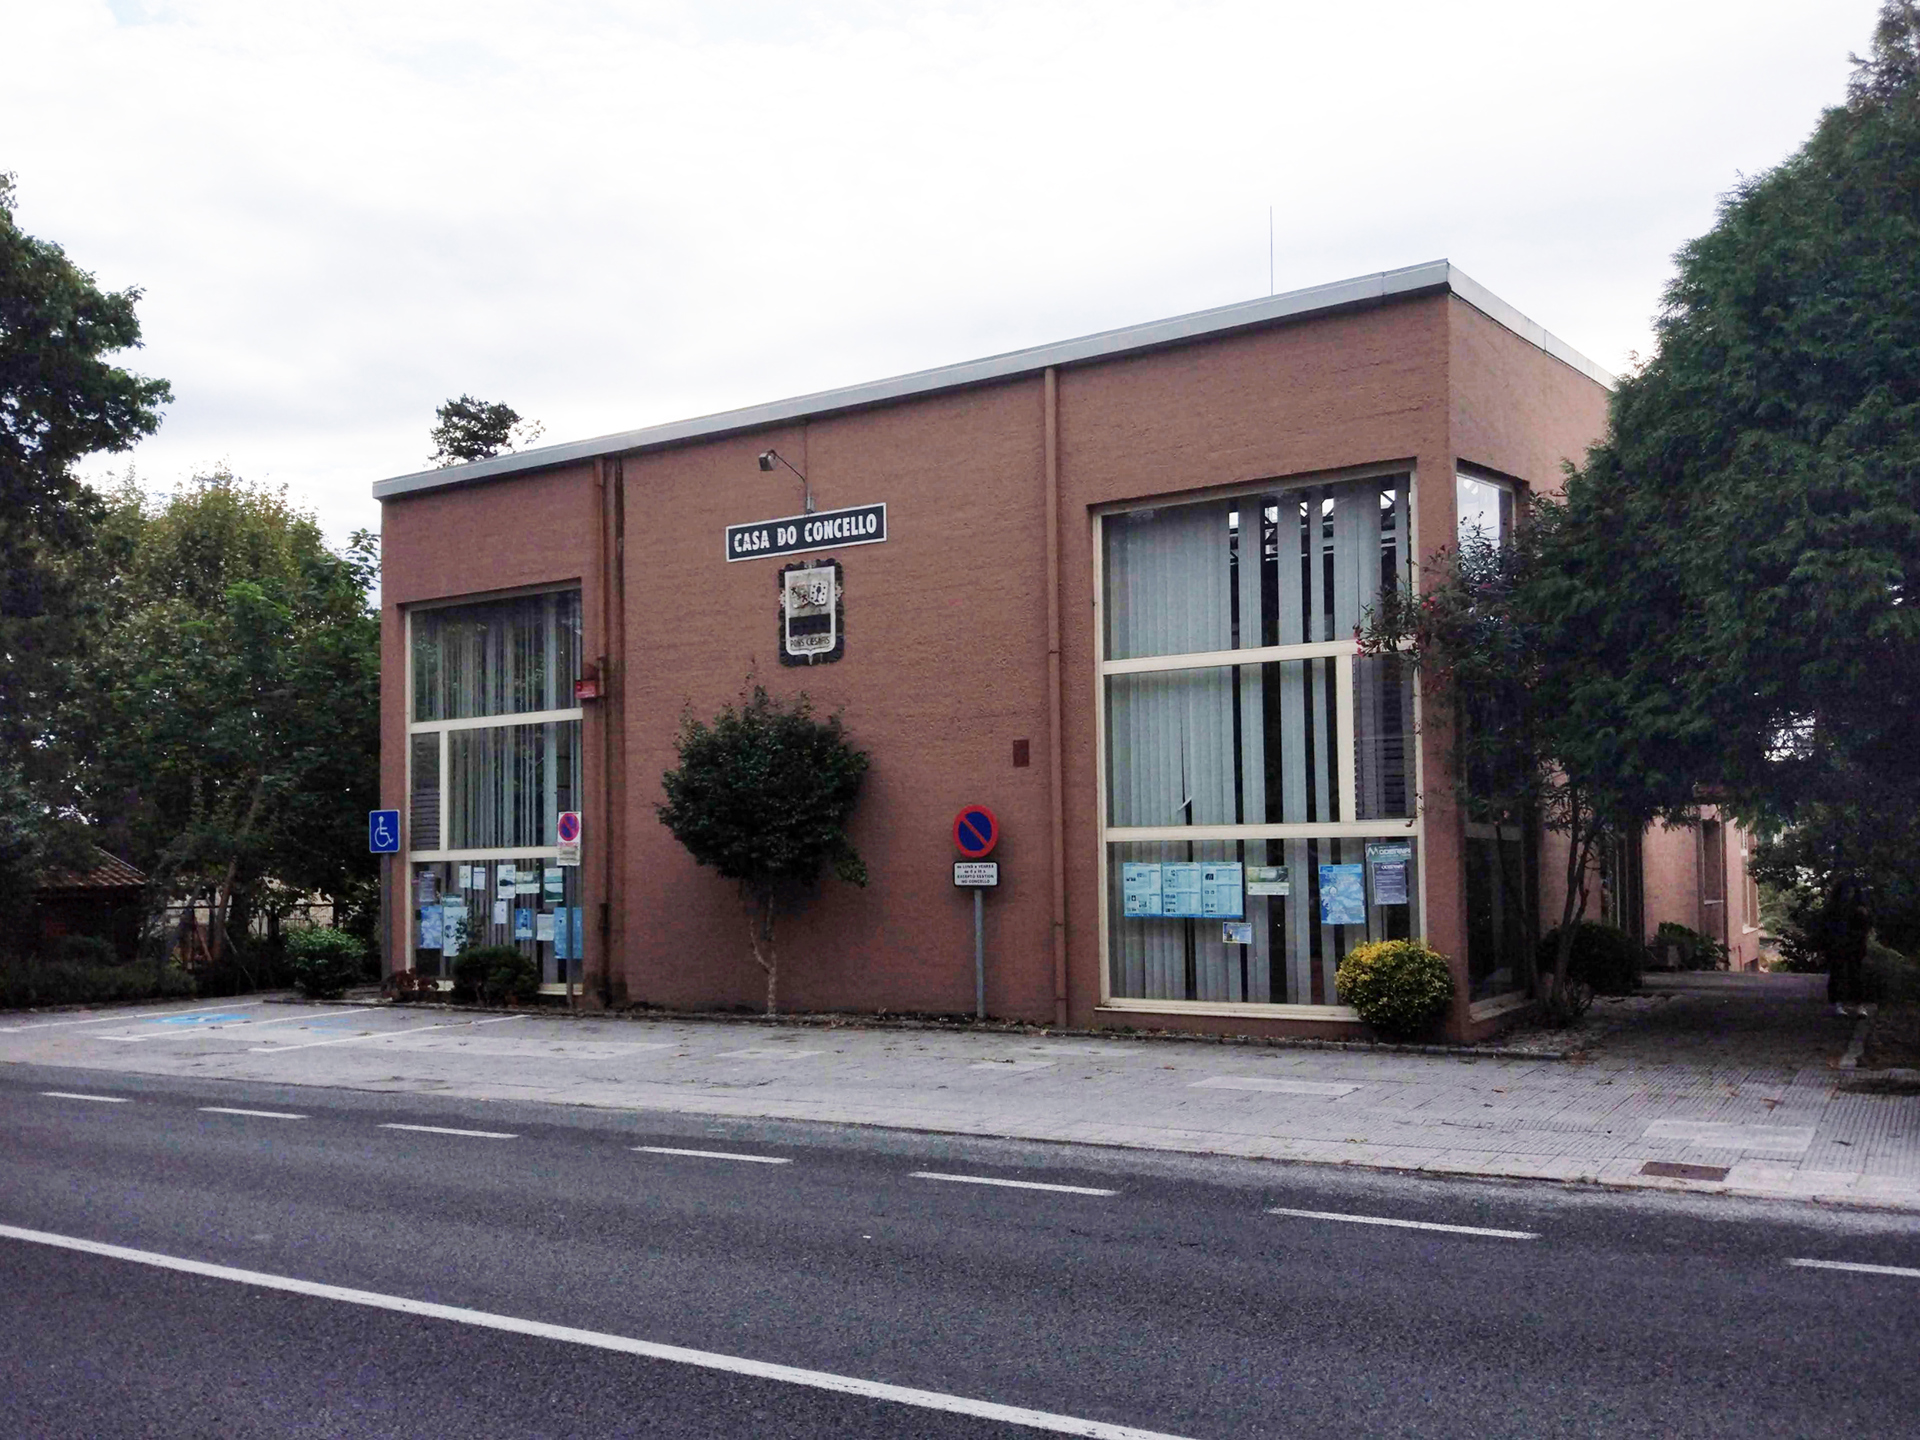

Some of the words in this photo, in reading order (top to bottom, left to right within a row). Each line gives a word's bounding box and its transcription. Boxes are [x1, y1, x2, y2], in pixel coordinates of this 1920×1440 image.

[734, 530, 770, 553] CASA
[776, 525, 797, 546] DO
[804, 513, 876, 542] CONCELLO
